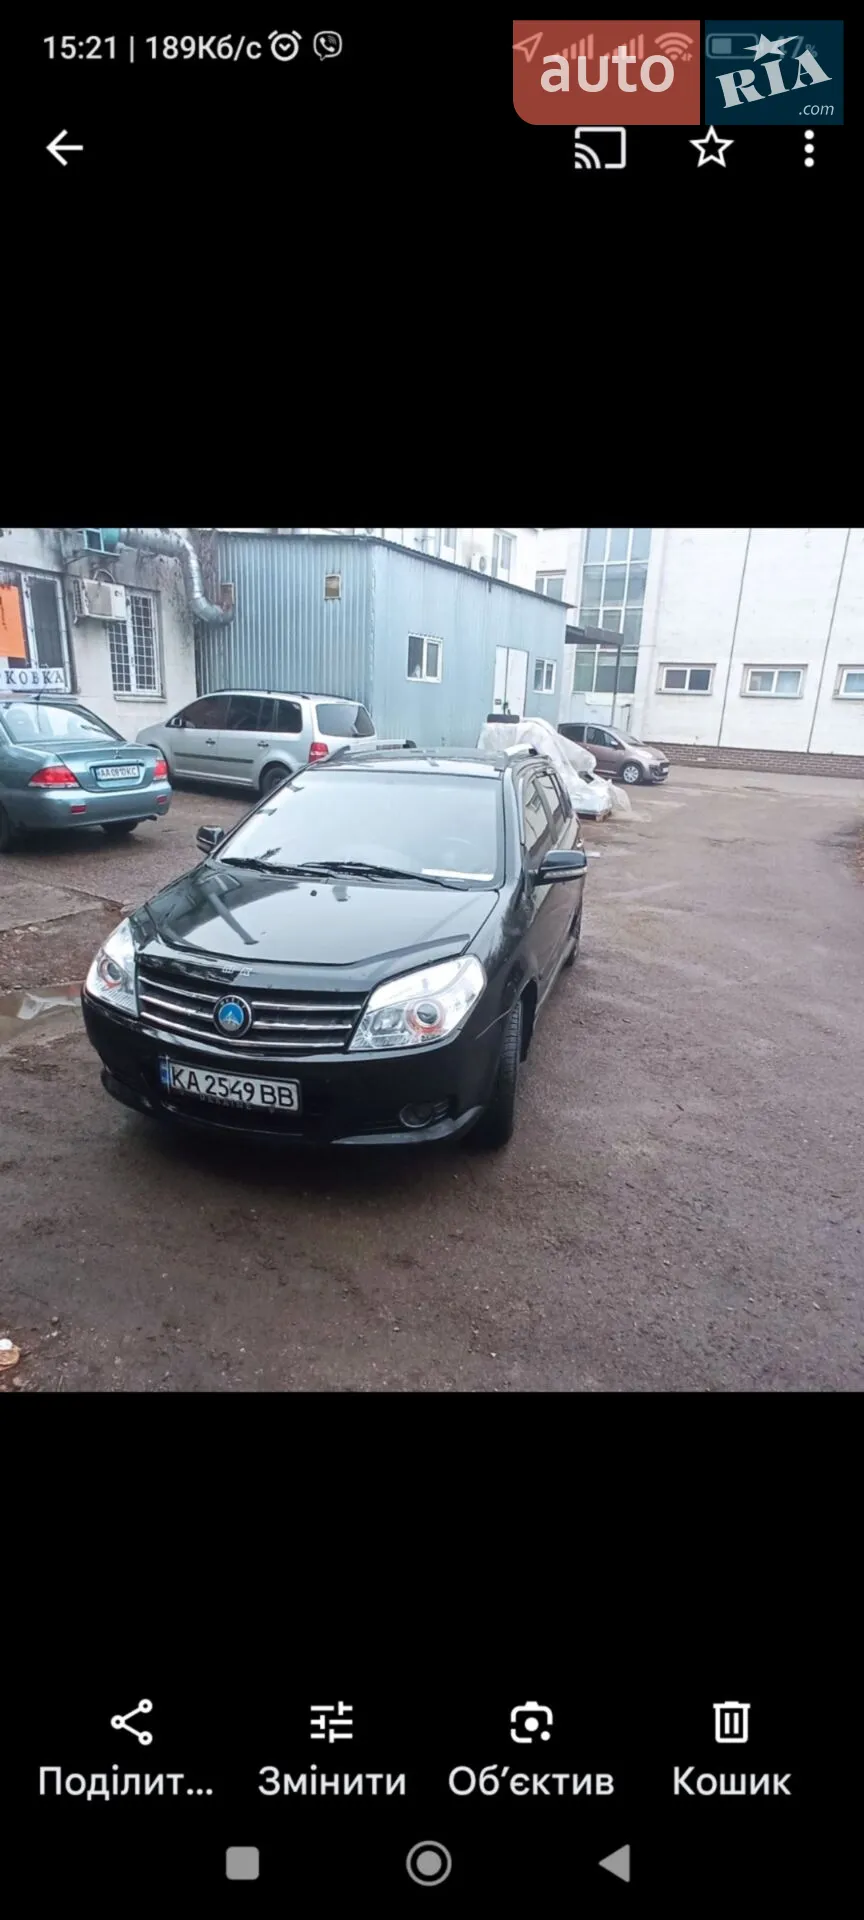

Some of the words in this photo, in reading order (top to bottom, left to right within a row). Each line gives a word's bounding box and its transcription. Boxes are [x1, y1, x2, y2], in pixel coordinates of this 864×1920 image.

[43, 35, 116, 60] 15:21
[145, 33, 263, 62] 189Кб/с
[0, 670, 65, 685] КОВКА
[171, 1065, 201, 1092] KA
[204, 1074, 255, 1102] 2549
[260, 1083, 294, 1108] BB
[39, 1763, 214, 1802] Поділит...
[258, 1764, 407, 1797] Змінити
[448, 1763, 615, 1797] Об’єктив
[673, 1766, 792, 1797] Кошик
